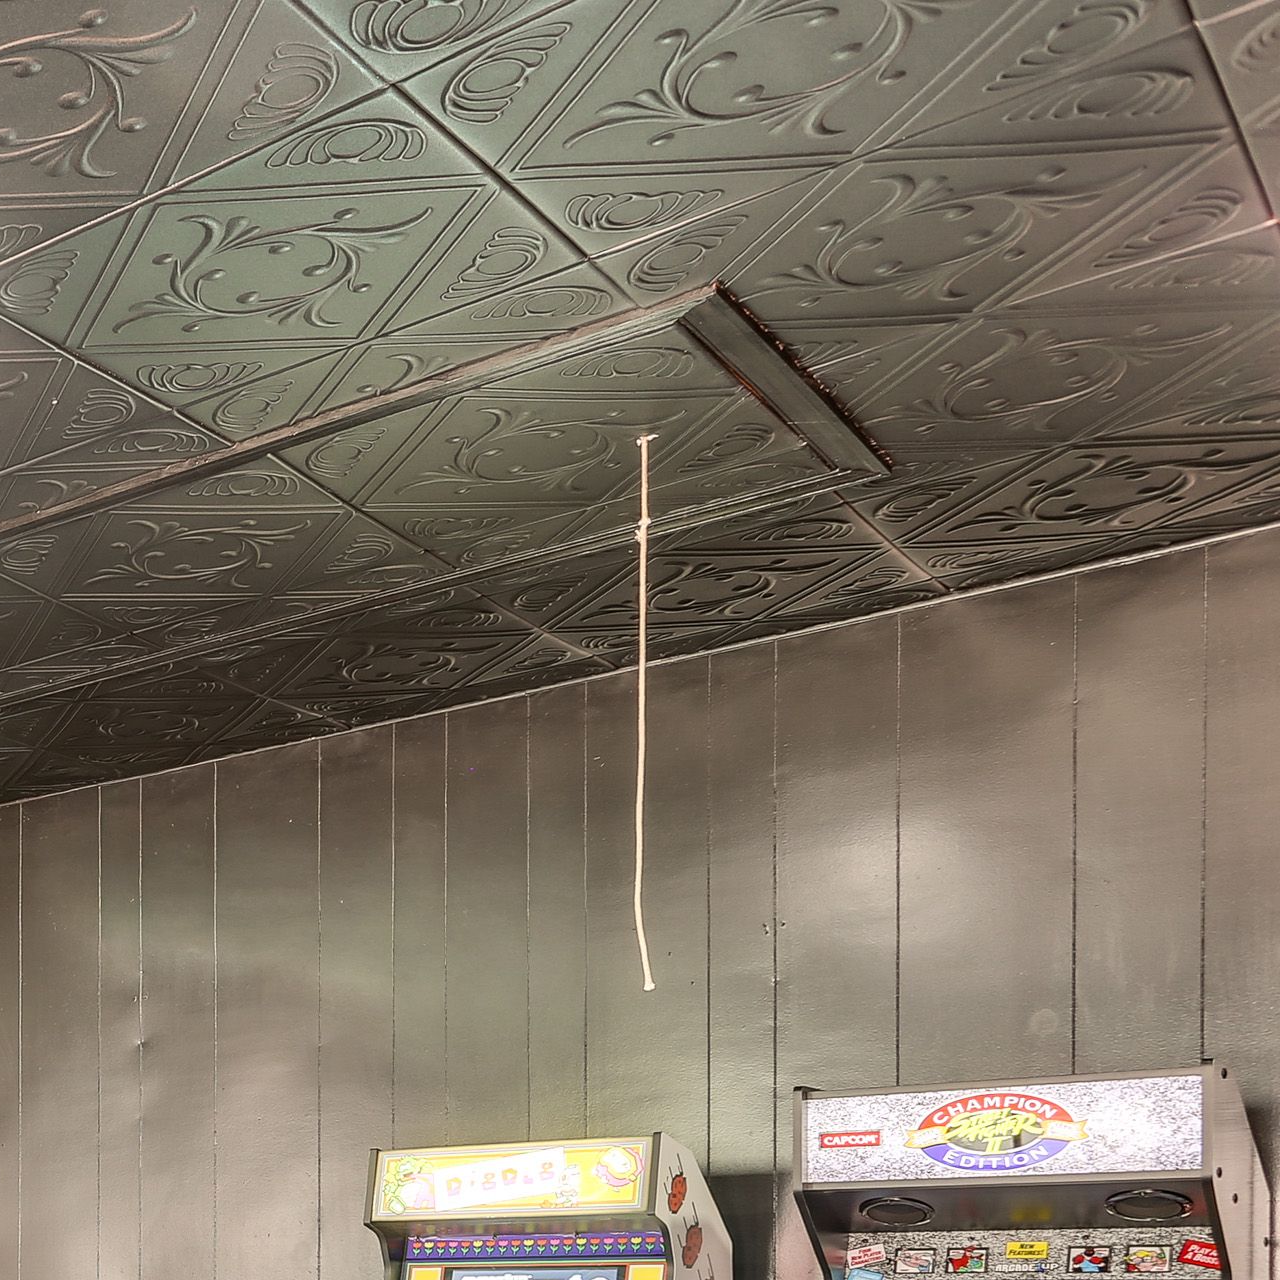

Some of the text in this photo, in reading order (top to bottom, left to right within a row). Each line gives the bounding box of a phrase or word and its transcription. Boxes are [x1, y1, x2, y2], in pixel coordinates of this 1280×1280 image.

[932, 1096, 1058, 1124] CHAMPION
[823, 1135, 878, 1145] CAPCOM
[943, 1146, 1049, 1169] EDITION
[1187, 1244, 1212, 1255] PLAY
